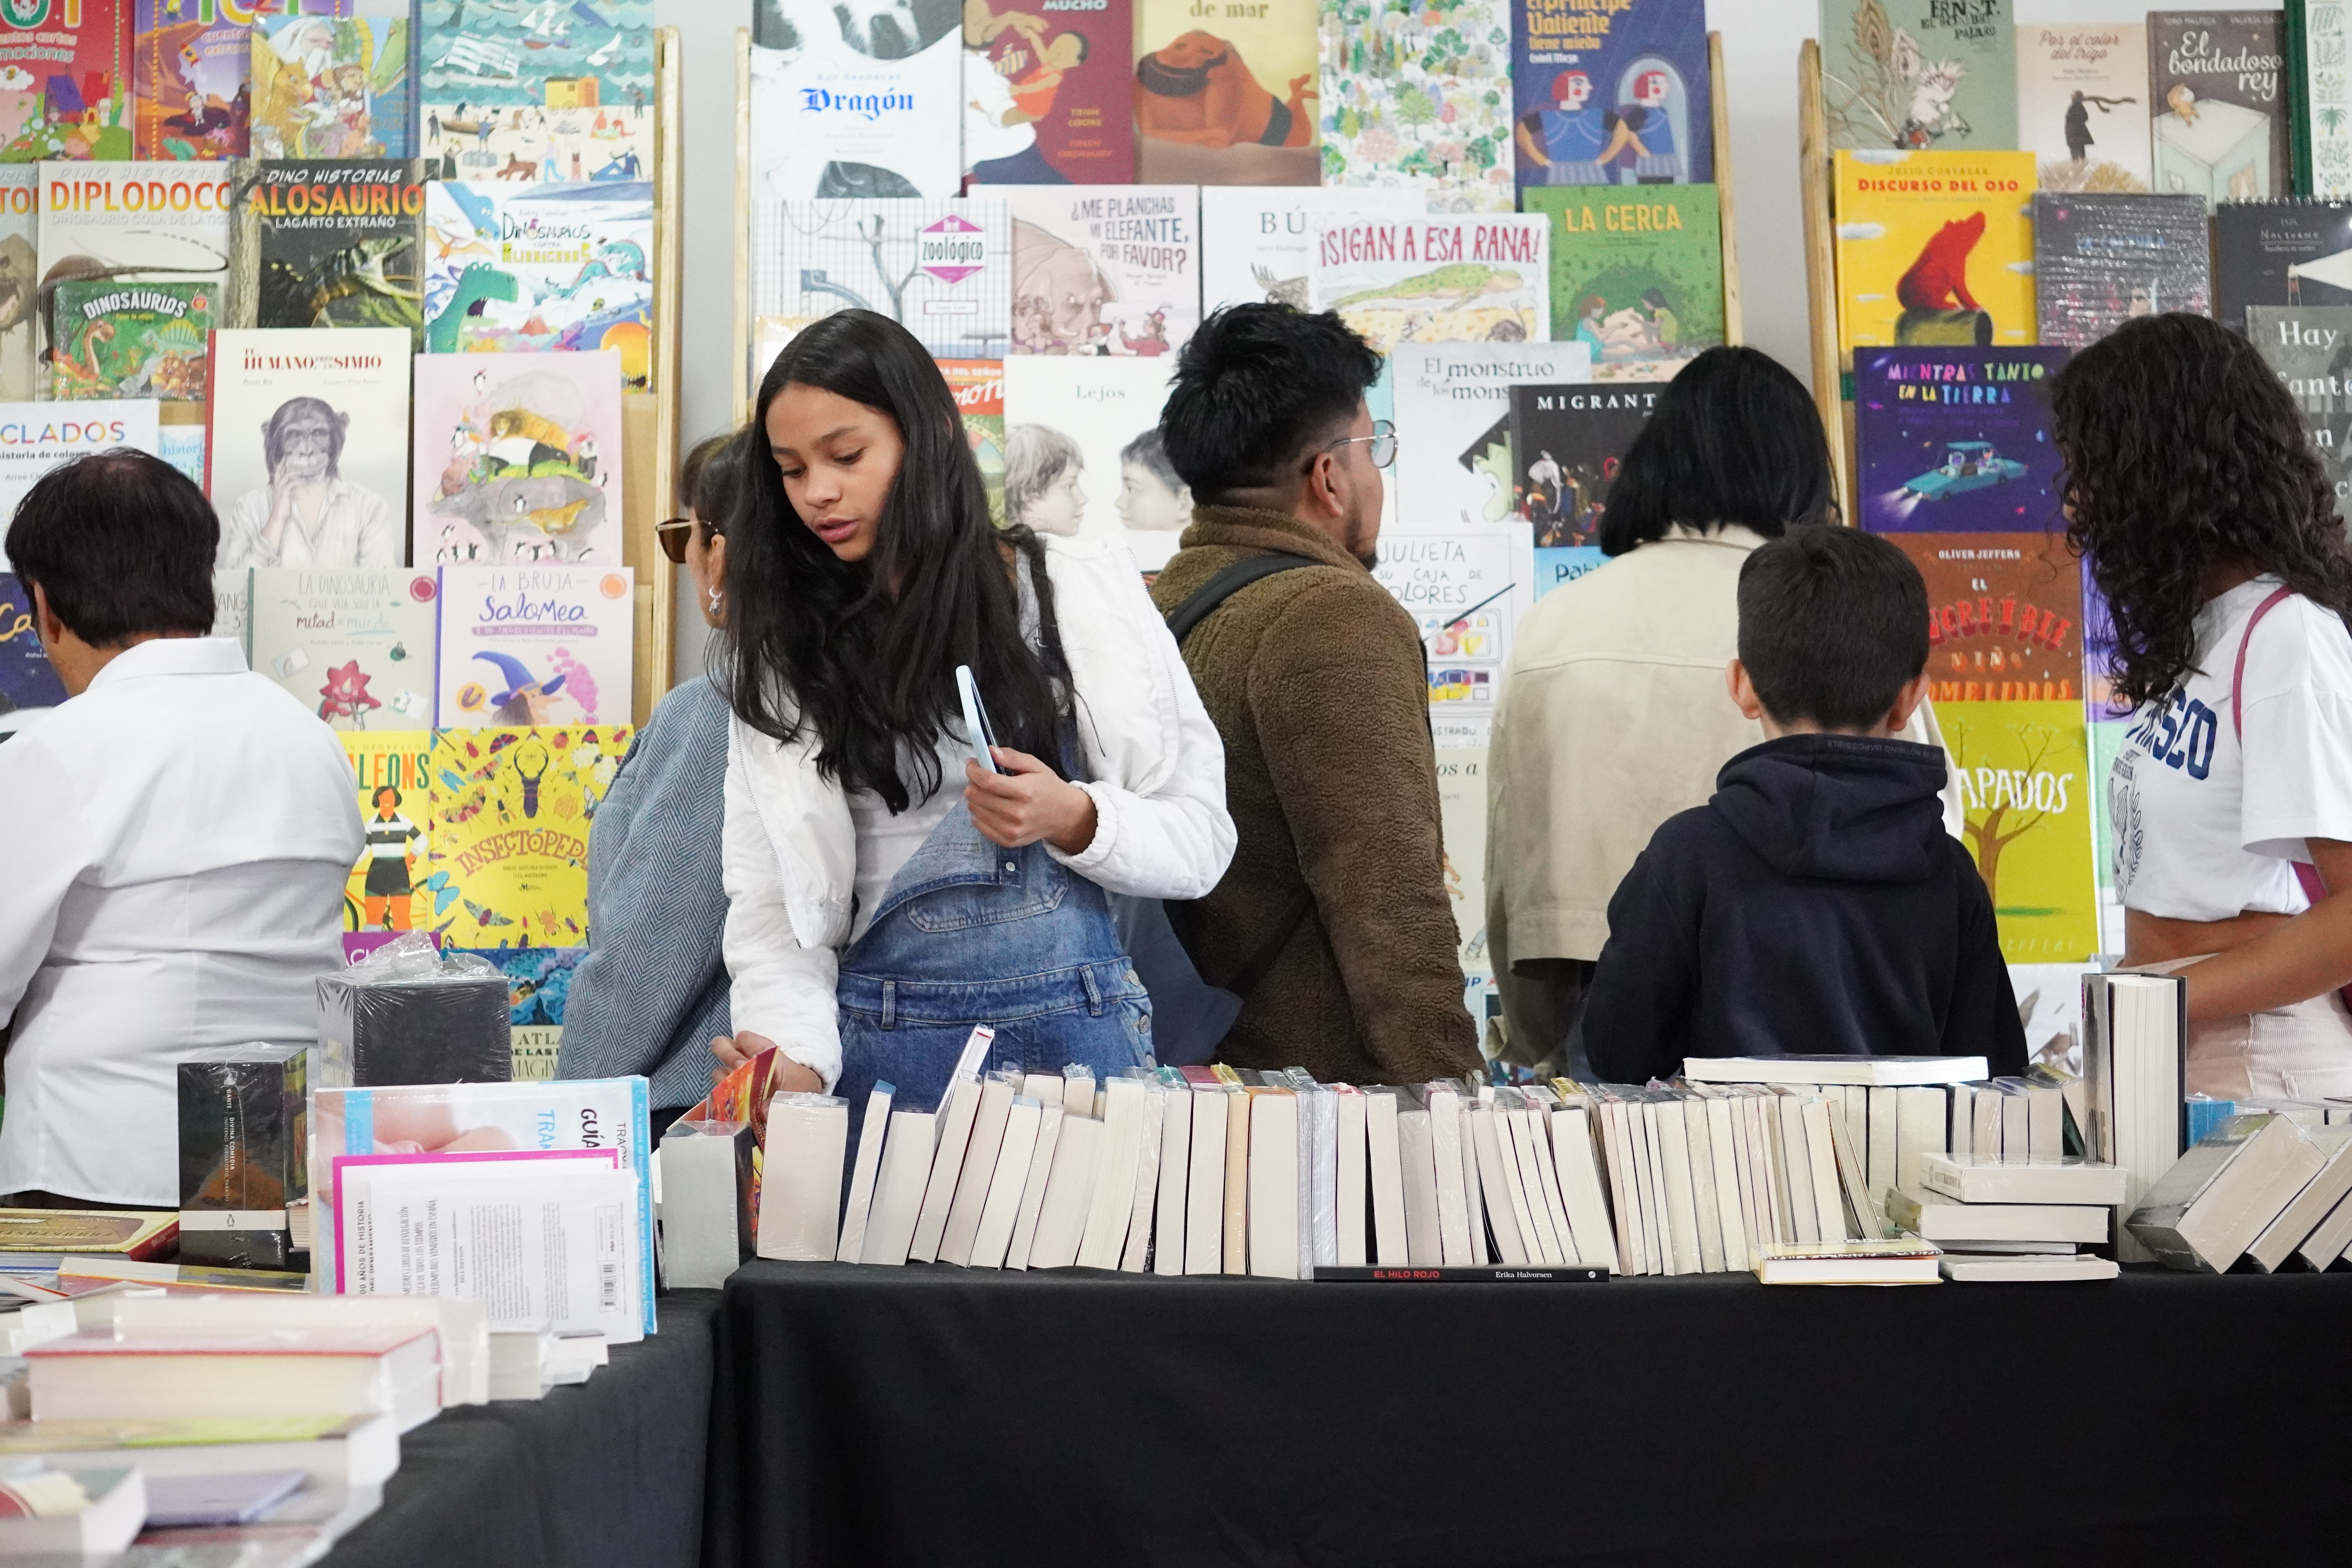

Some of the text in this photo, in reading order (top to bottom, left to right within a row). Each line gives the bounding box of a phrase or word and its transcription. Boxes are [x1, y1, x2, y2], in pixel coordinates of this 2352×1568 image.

[1189, 0, 1269, 18] de mar
[2181, 30, 2209, 58] El
[2168, 46, 2283, 75] bondadoso
[2238, 72, 2278, 102] rey
[797, 87, 914, 121] Dragón
[267, 169, 402, 184] DINO HISTORIAS
[1858, 178, 2019, 192] DISCURSO DEL OSO
[249, 184, 424, 216] ALOSAURIO
[1071, 197, 1175, 221] ¿ME PLANCHAS
[275, 215, 396, 229] LAGARTO EXTRAÑO
[1565, 204, 1682, 232] LA CERCA
[1105, 218, 1189, 243] ELEFANTE,
[922, 236, 983, 264] zoológico
[1320, 225, 1540, 267] ¡SIGAN A ESA RANA!
[1100, 243, 1187, 274] POR FAVOR?
[83, 291, 187, 320] DINOSAURIOS
[2278, 321, 2339, 351] Hay
[334, 355, 382, 370] SIMIO
[1425, 358, 1554, 377] El monstruo
[1888, 362, 2044, 382] MIENTRAS TANTO
[1416, 375, 1430, 388] de
[1076, 385, 1125, 403] Lejos
[1537, 393, 1657, 410] MIGRANT
[1898, 384, 2011, 405] EN LA TIERRA
[0, 421, 125, 445] CLADOS
[39, 450, 51, 459] de
[1377, 540, 1465, 564] JULIETA
[1938, 549, 2021, 560] OLIVER JEFFERS
[319, 574, 390, 596] DINOSAURIA
[492, 571, 572, 593] LA BRUJA
[1379, 568, 1483, 583] SU CAJA DE
[1971, 578, 1988, 591] EL
[1466, 763, 1477, 775] a
[526, 1048, 552, 1056] LAS
[581, 1109, 604, 1148] GUÍA
[356, 1200, 365, 1240] HISTORIA
[358, 1244, 365, 1254] DE
[415, 1247, 424, 1256] LOS
[428, 1229, 439, 1257] VENDIDOS
[357, 1257, 366, 1281] AÑOS
[415, 1257, 425, 1273] TODOS
[1414, 1271, 1440, 1279] ROJO
